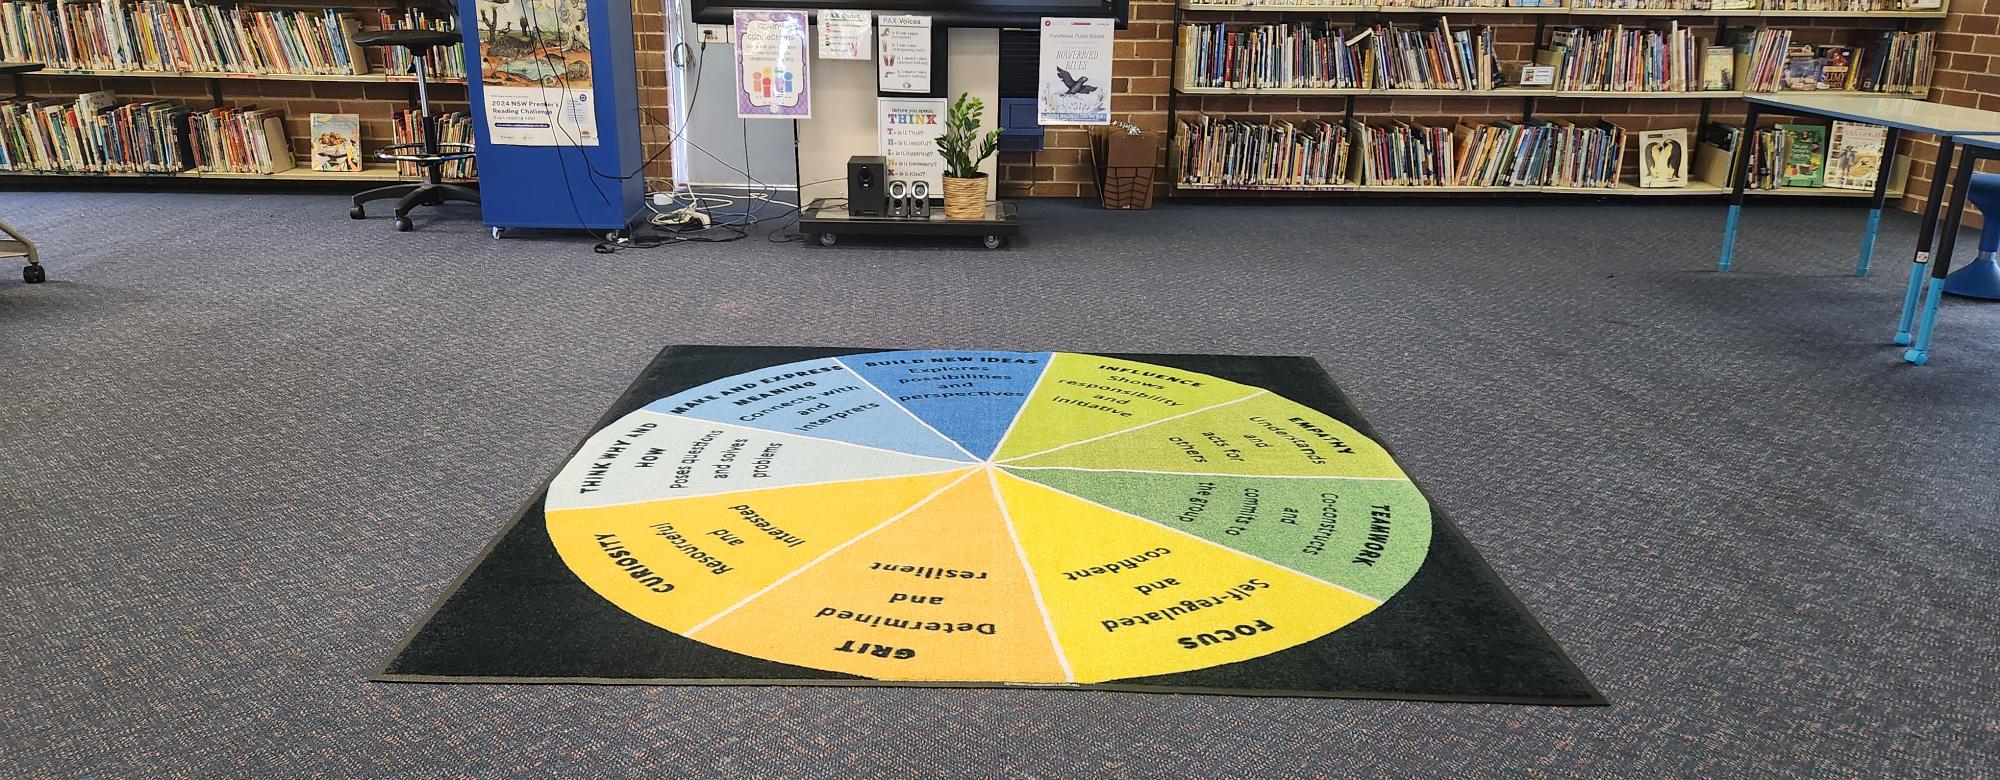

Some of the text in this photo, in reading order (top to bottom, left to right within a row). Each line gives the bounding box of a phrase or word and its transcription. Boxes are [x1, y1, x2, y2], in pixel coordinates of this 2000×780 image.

[899, 17, 921, 25] Voices
[1056, 50, 1099, 59] BOWERBIRD
[1066, 61, 1087, 70] BLUES
[1822, 72, 1848, 82] SLIMY
[888, 114, 937, 124] THINK
[865, 359, 924, 367] BUILD
[908, 366, 991, 374] Explores
[899, 374, 1013, 384] possibilities
[938, 382, 973, 390] and
[1098, 365, 1205, 388] INFLUENCE
[1107, 376, 1166, 390] Shows
[670, 366, 844, 415] MAKE AND EXPRESS
[733, 381, 817, 406] MEANING
[899, 390, 1024, 402] perspectives
[1058, 378, 1184, 407] responsibility
[1093, 394, 1130, 405] and
[740, 386, 861, 422] Connects with
[797, 403, 831, 416] and
[1202, 432, 1245, 462] acts for
[1244, 434, 1274, 448] and
[1250, 416, 1326, 465] Understands
[1288, 417, 1356, 455] EMPATHY
[580, 423, 658, 495] THINK WHY AND
[635, 447, 668, 468] HOW
[670, 430, 725, 489] Poses questions
[712, 438, 749, 479] and solves
[751, 442, 783, 478] problems
[1169, 436, 1208, 464] others
[1179, 482, 1216, 523] the group
[1226, 488, 1260, 536] commits to
[1280, 507, 1299, 526] and
[1302, 493, 1339, 556] Co-constructs
[706, 528, 745, 547] and
[1352, 505, 1391, 567] TEAMWORK
[649, 523, 734, 576] Resourceful
[594, 534, 675, 593] CURIOSITY
[870, 562, 988, 580] resilient
[1062, 547, 1172, 581] confident
[1134, 577, 1181, 596] and
[888, 593, 944, 605] and
[1101, 578, 1270, 633] Self-regulated
[815, 607, 997, 635] Determined
[1177, 619, 1276, 650] FOCUS
[833, 640, 916, 659] GRIT
